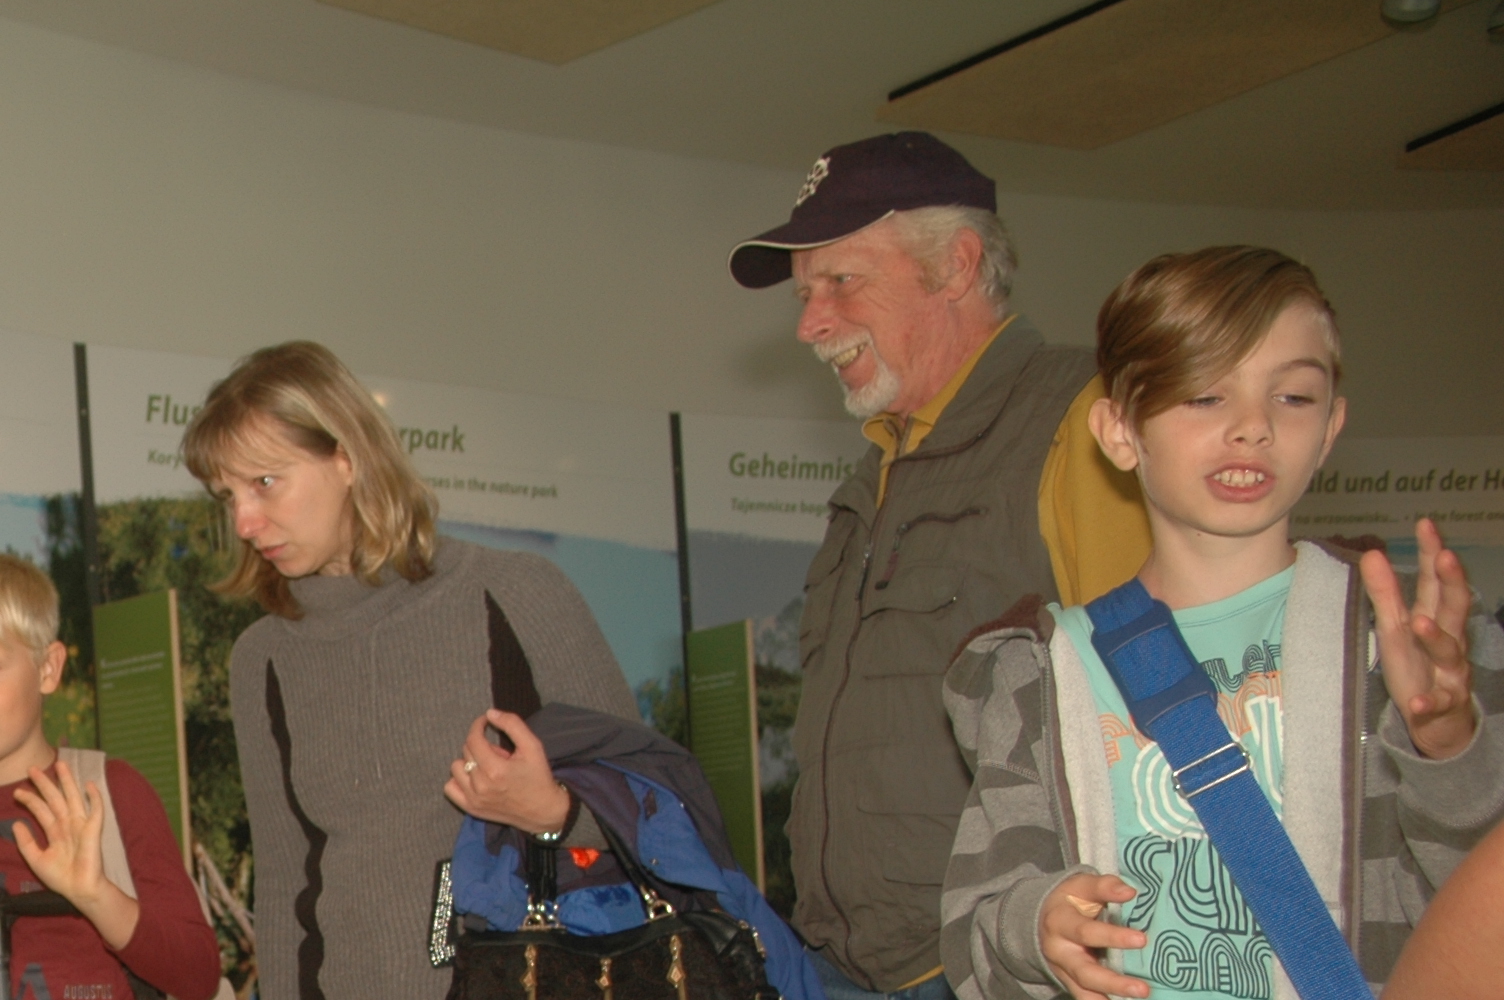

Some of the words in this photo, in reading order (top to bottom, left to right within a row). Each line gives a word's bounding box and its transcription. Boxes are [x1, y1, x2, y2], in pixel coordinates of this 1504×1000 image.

[399, 425, 465, 454] rpark
[729, 451, 854, 481] Geheimnis
[468, 476, 486, 492] the
[489, 481, 529, 495] nature
[532, 485, 558, 499] park
[1346, 470, 1390, 493] und
[1396, 469, 1436, 492] auf
[1439, 469, 1478, 492] der
[1449, 510, 1484, 522] forest
[64, 984, 113, 1000] AUGUSTUS
